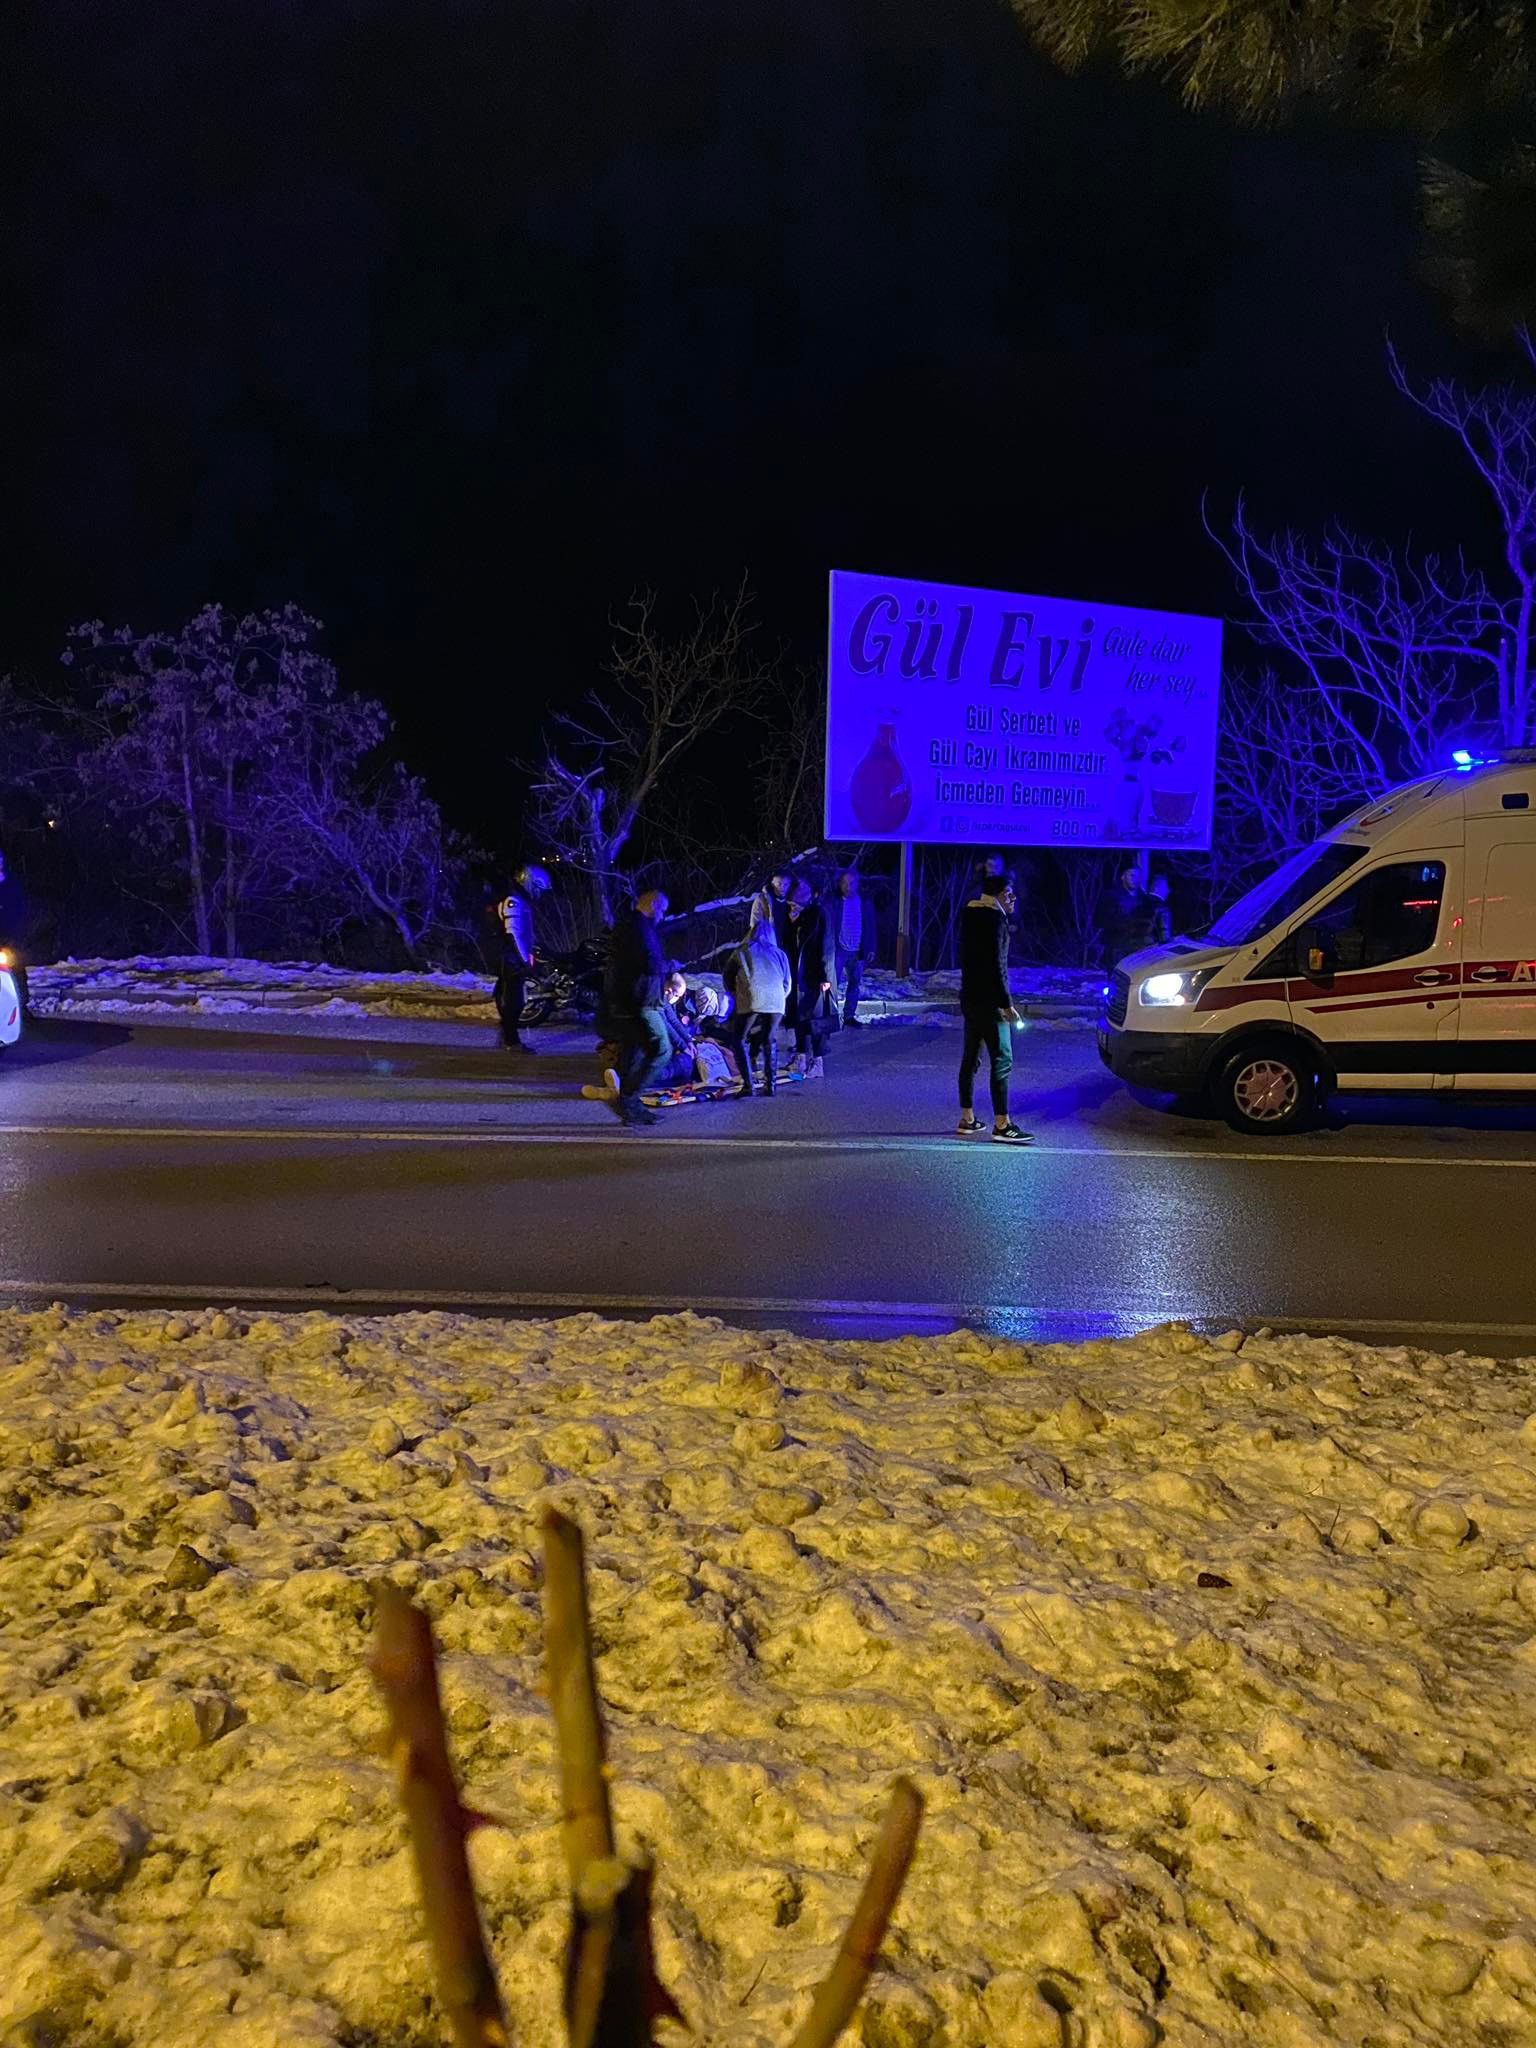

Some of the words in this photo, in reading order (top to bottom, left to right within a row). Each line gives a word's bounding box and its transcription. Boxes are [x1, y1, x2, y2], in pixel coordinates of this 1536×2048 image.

[848, 592, 975, 681] Gül
[990, 611, 1096, 692] Evi
[1125, 663, 1162, 692] her
[966, 704, 993, 732] Gül
[1065, 716, 1081, 736] ve
[929, 739, 957, 766] Gül
[1052, 820, 1080, 838] 800
[1083, 823, 1097, 837] m
